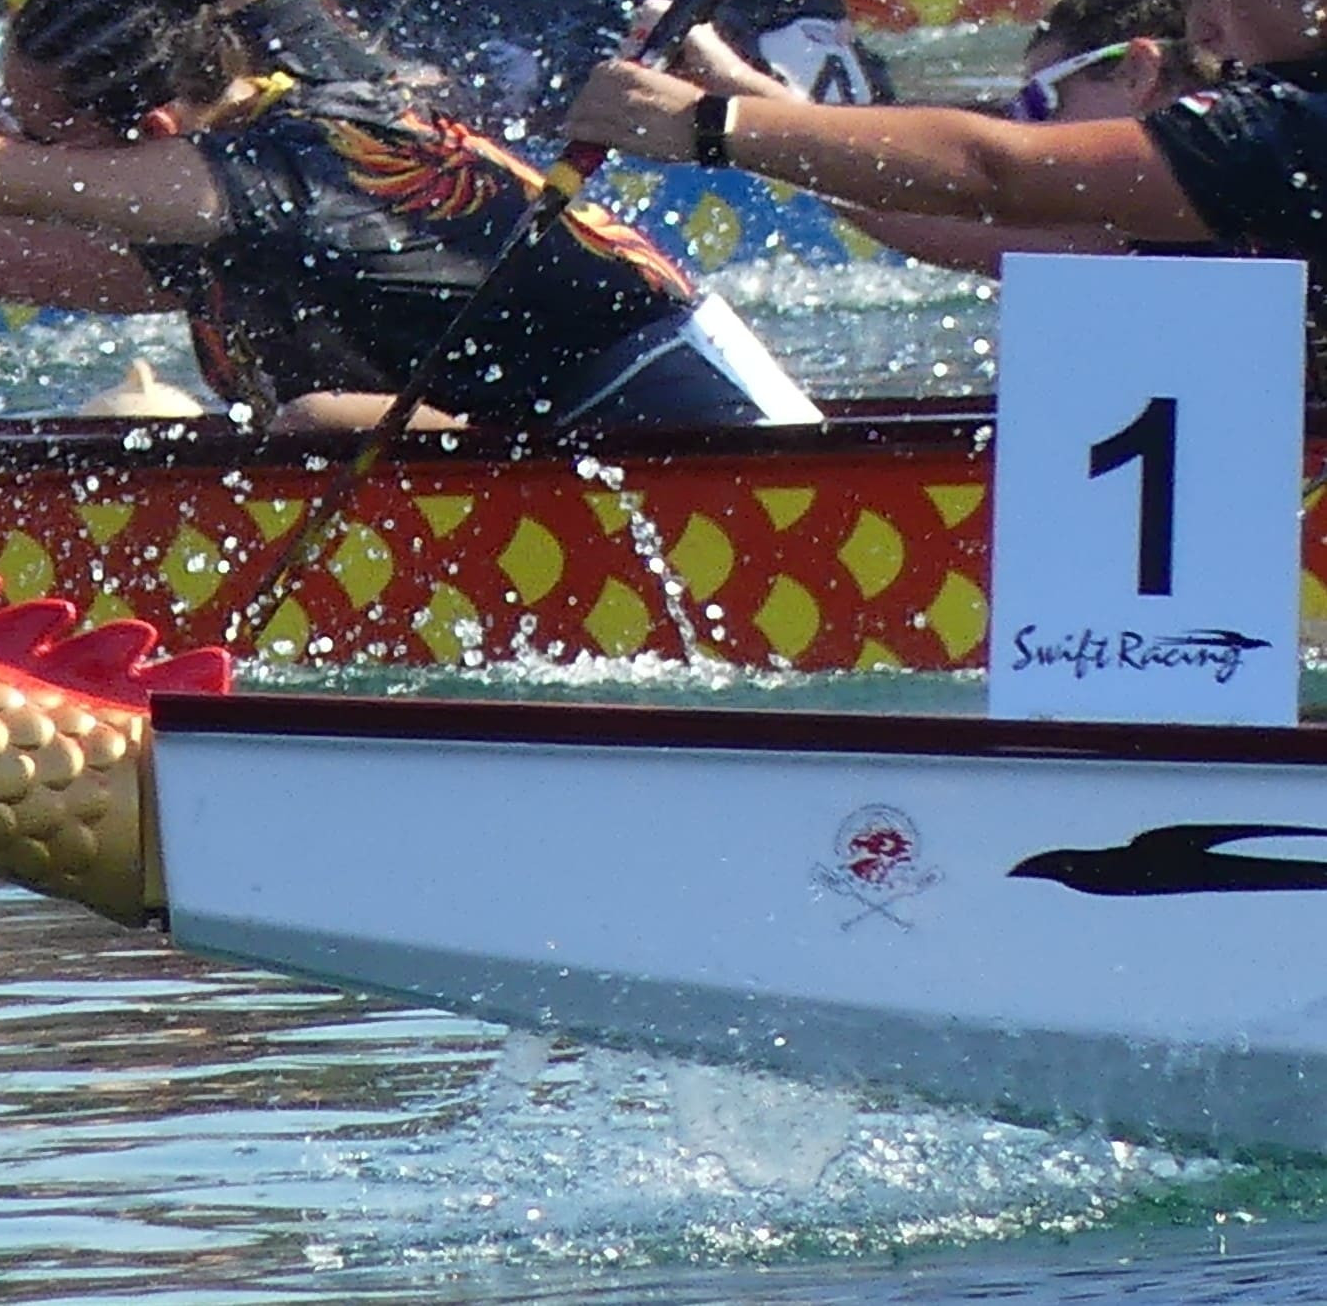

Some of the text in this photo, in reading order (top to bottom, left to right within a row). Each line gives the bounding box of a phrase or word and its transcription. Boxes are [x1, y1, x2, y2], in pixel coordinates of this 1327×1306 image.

[1088, 397, 1177, 596] 1
[1012, 624, 1243, 684] Swift Racing
